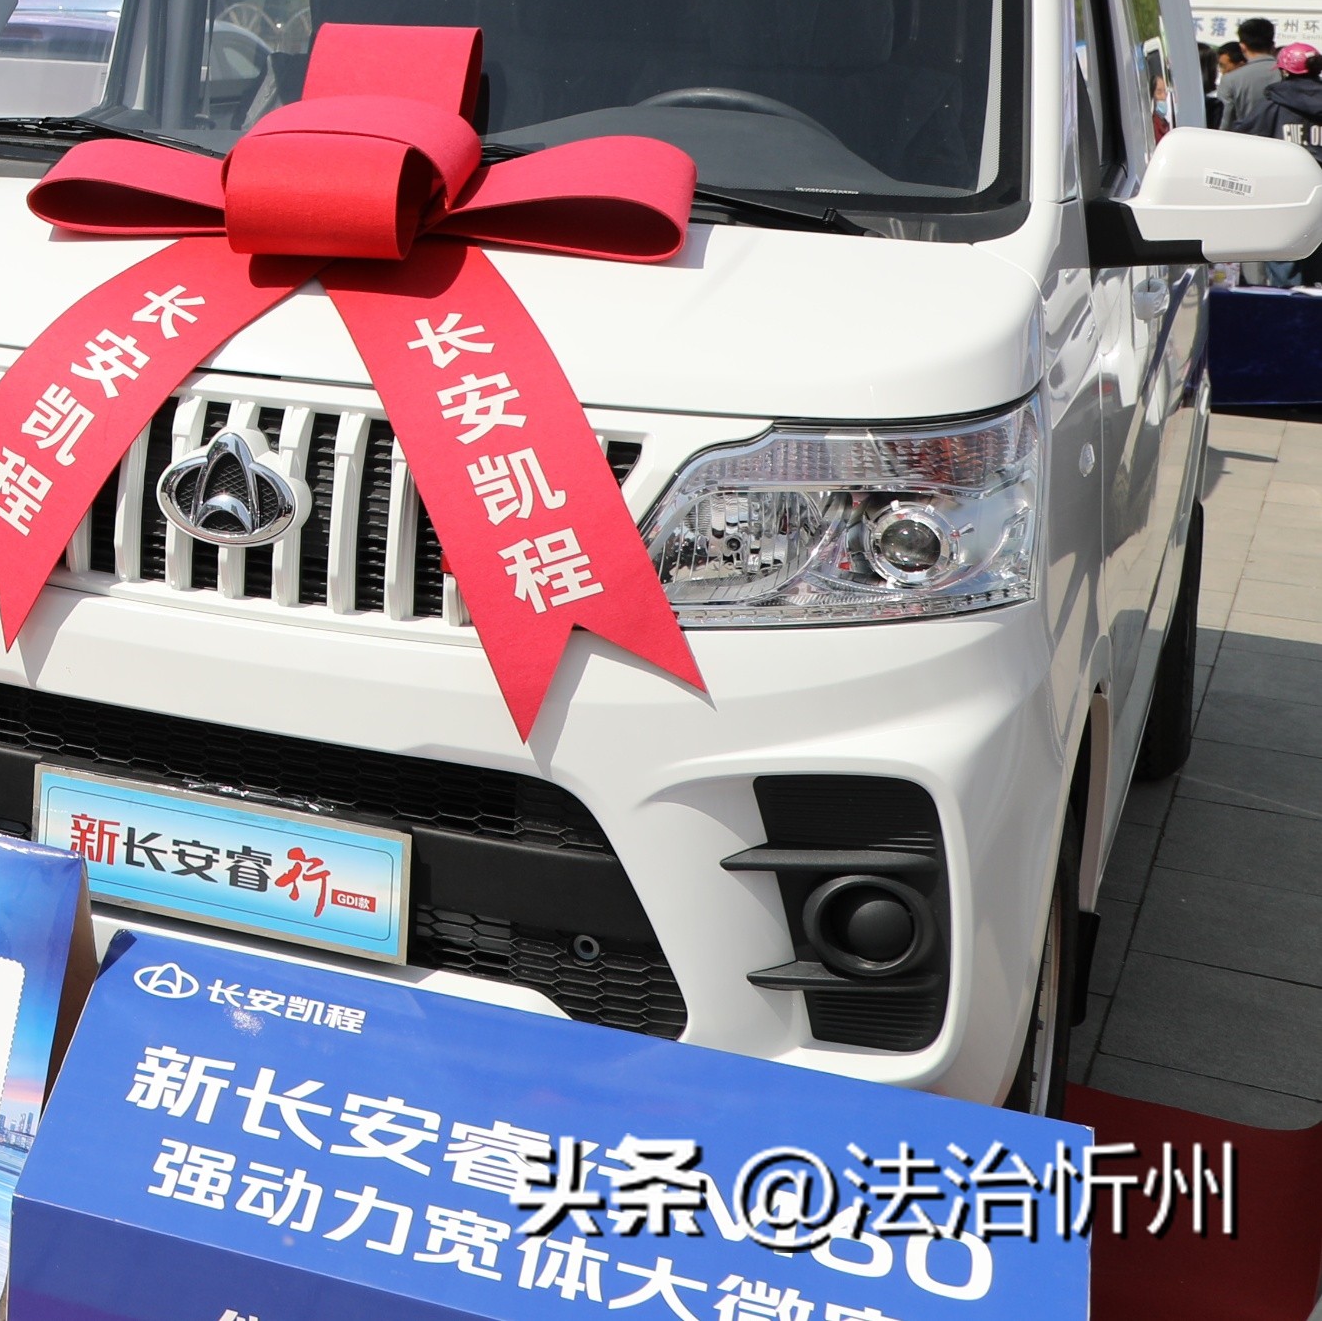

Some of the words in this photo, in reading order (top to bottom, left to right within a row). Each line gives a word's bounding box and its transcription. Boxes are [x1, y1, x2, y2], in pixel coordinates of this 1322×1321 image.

[406, 311, 605, 615] 长安凯程
[70, 812, 331, 919] 新长安睿行
[205, 978, 367, 1035] 长安凯程
[146, 1137, 913, 1321] 强动力宽体大微
